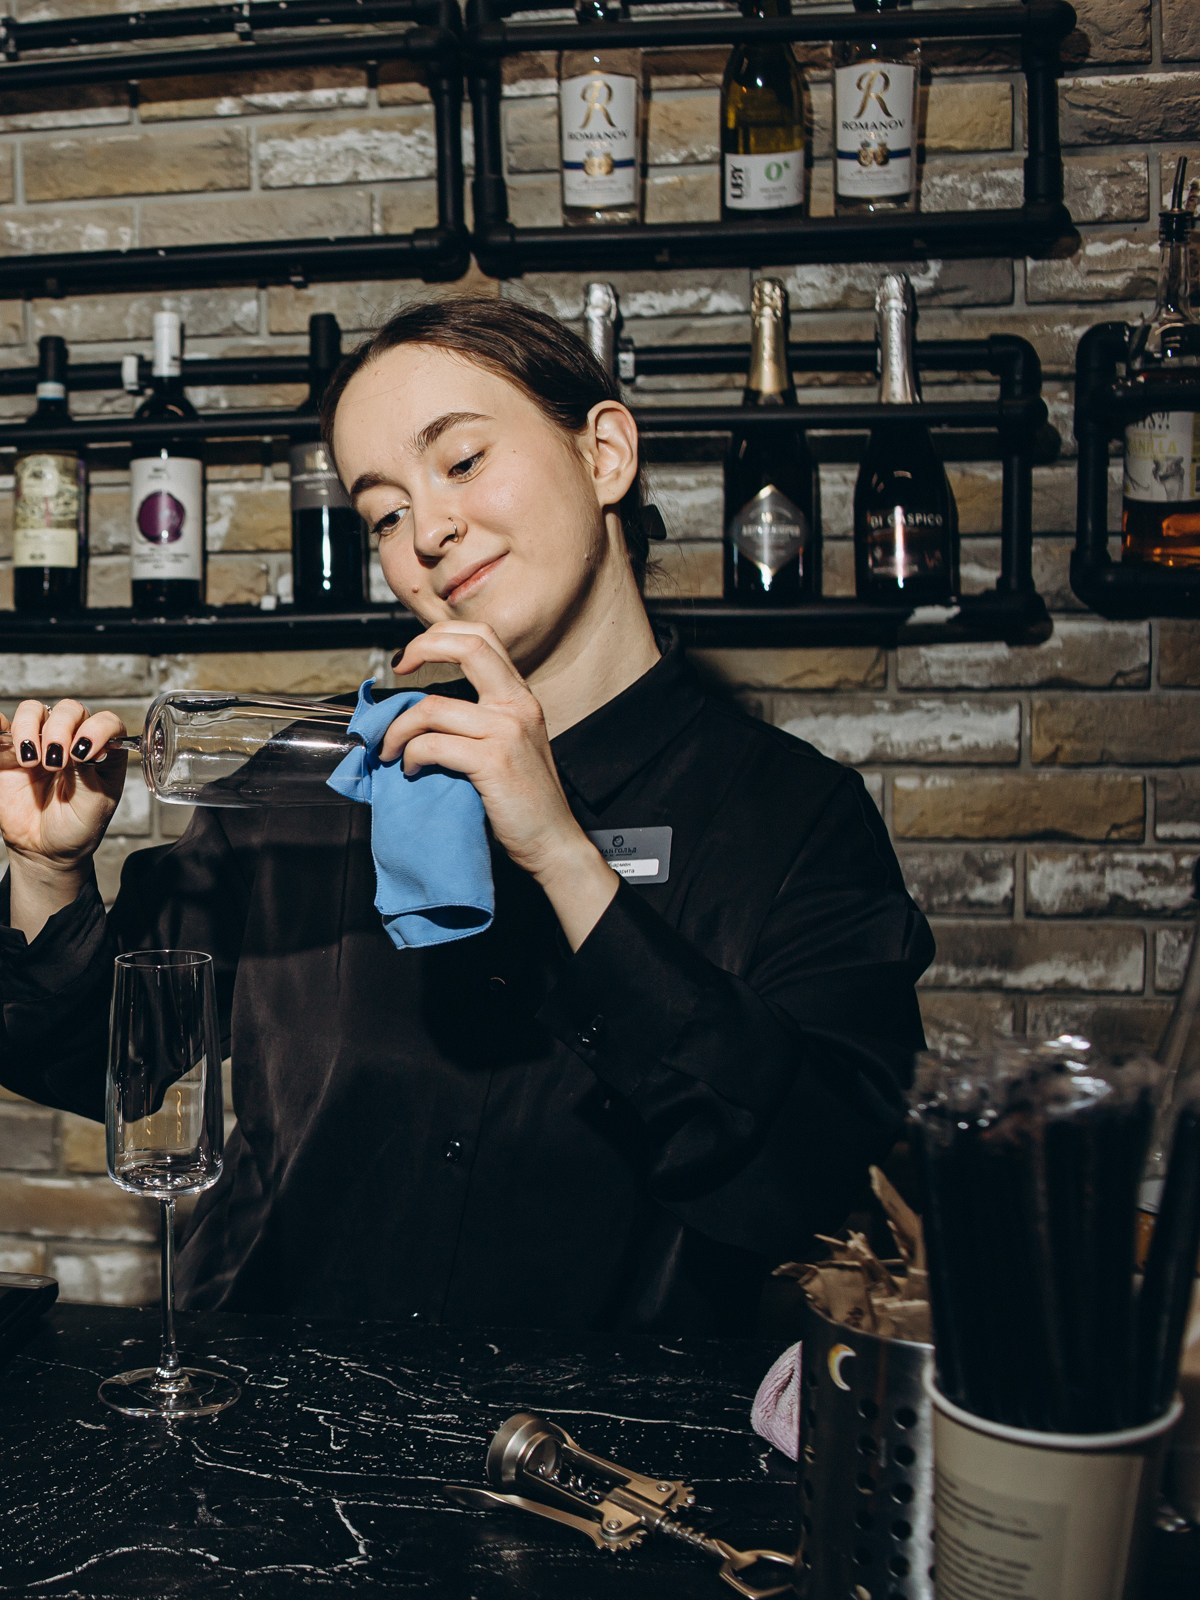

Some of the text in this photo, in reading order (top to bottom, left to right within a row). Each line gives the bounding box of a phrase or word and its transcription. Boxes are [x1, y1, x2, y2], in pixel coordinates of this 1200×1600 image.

[854, 69, 893, 119] R
[841, 119, 904, 132] ROMANOV
[567, 129, 629, 141] ROMANOV
